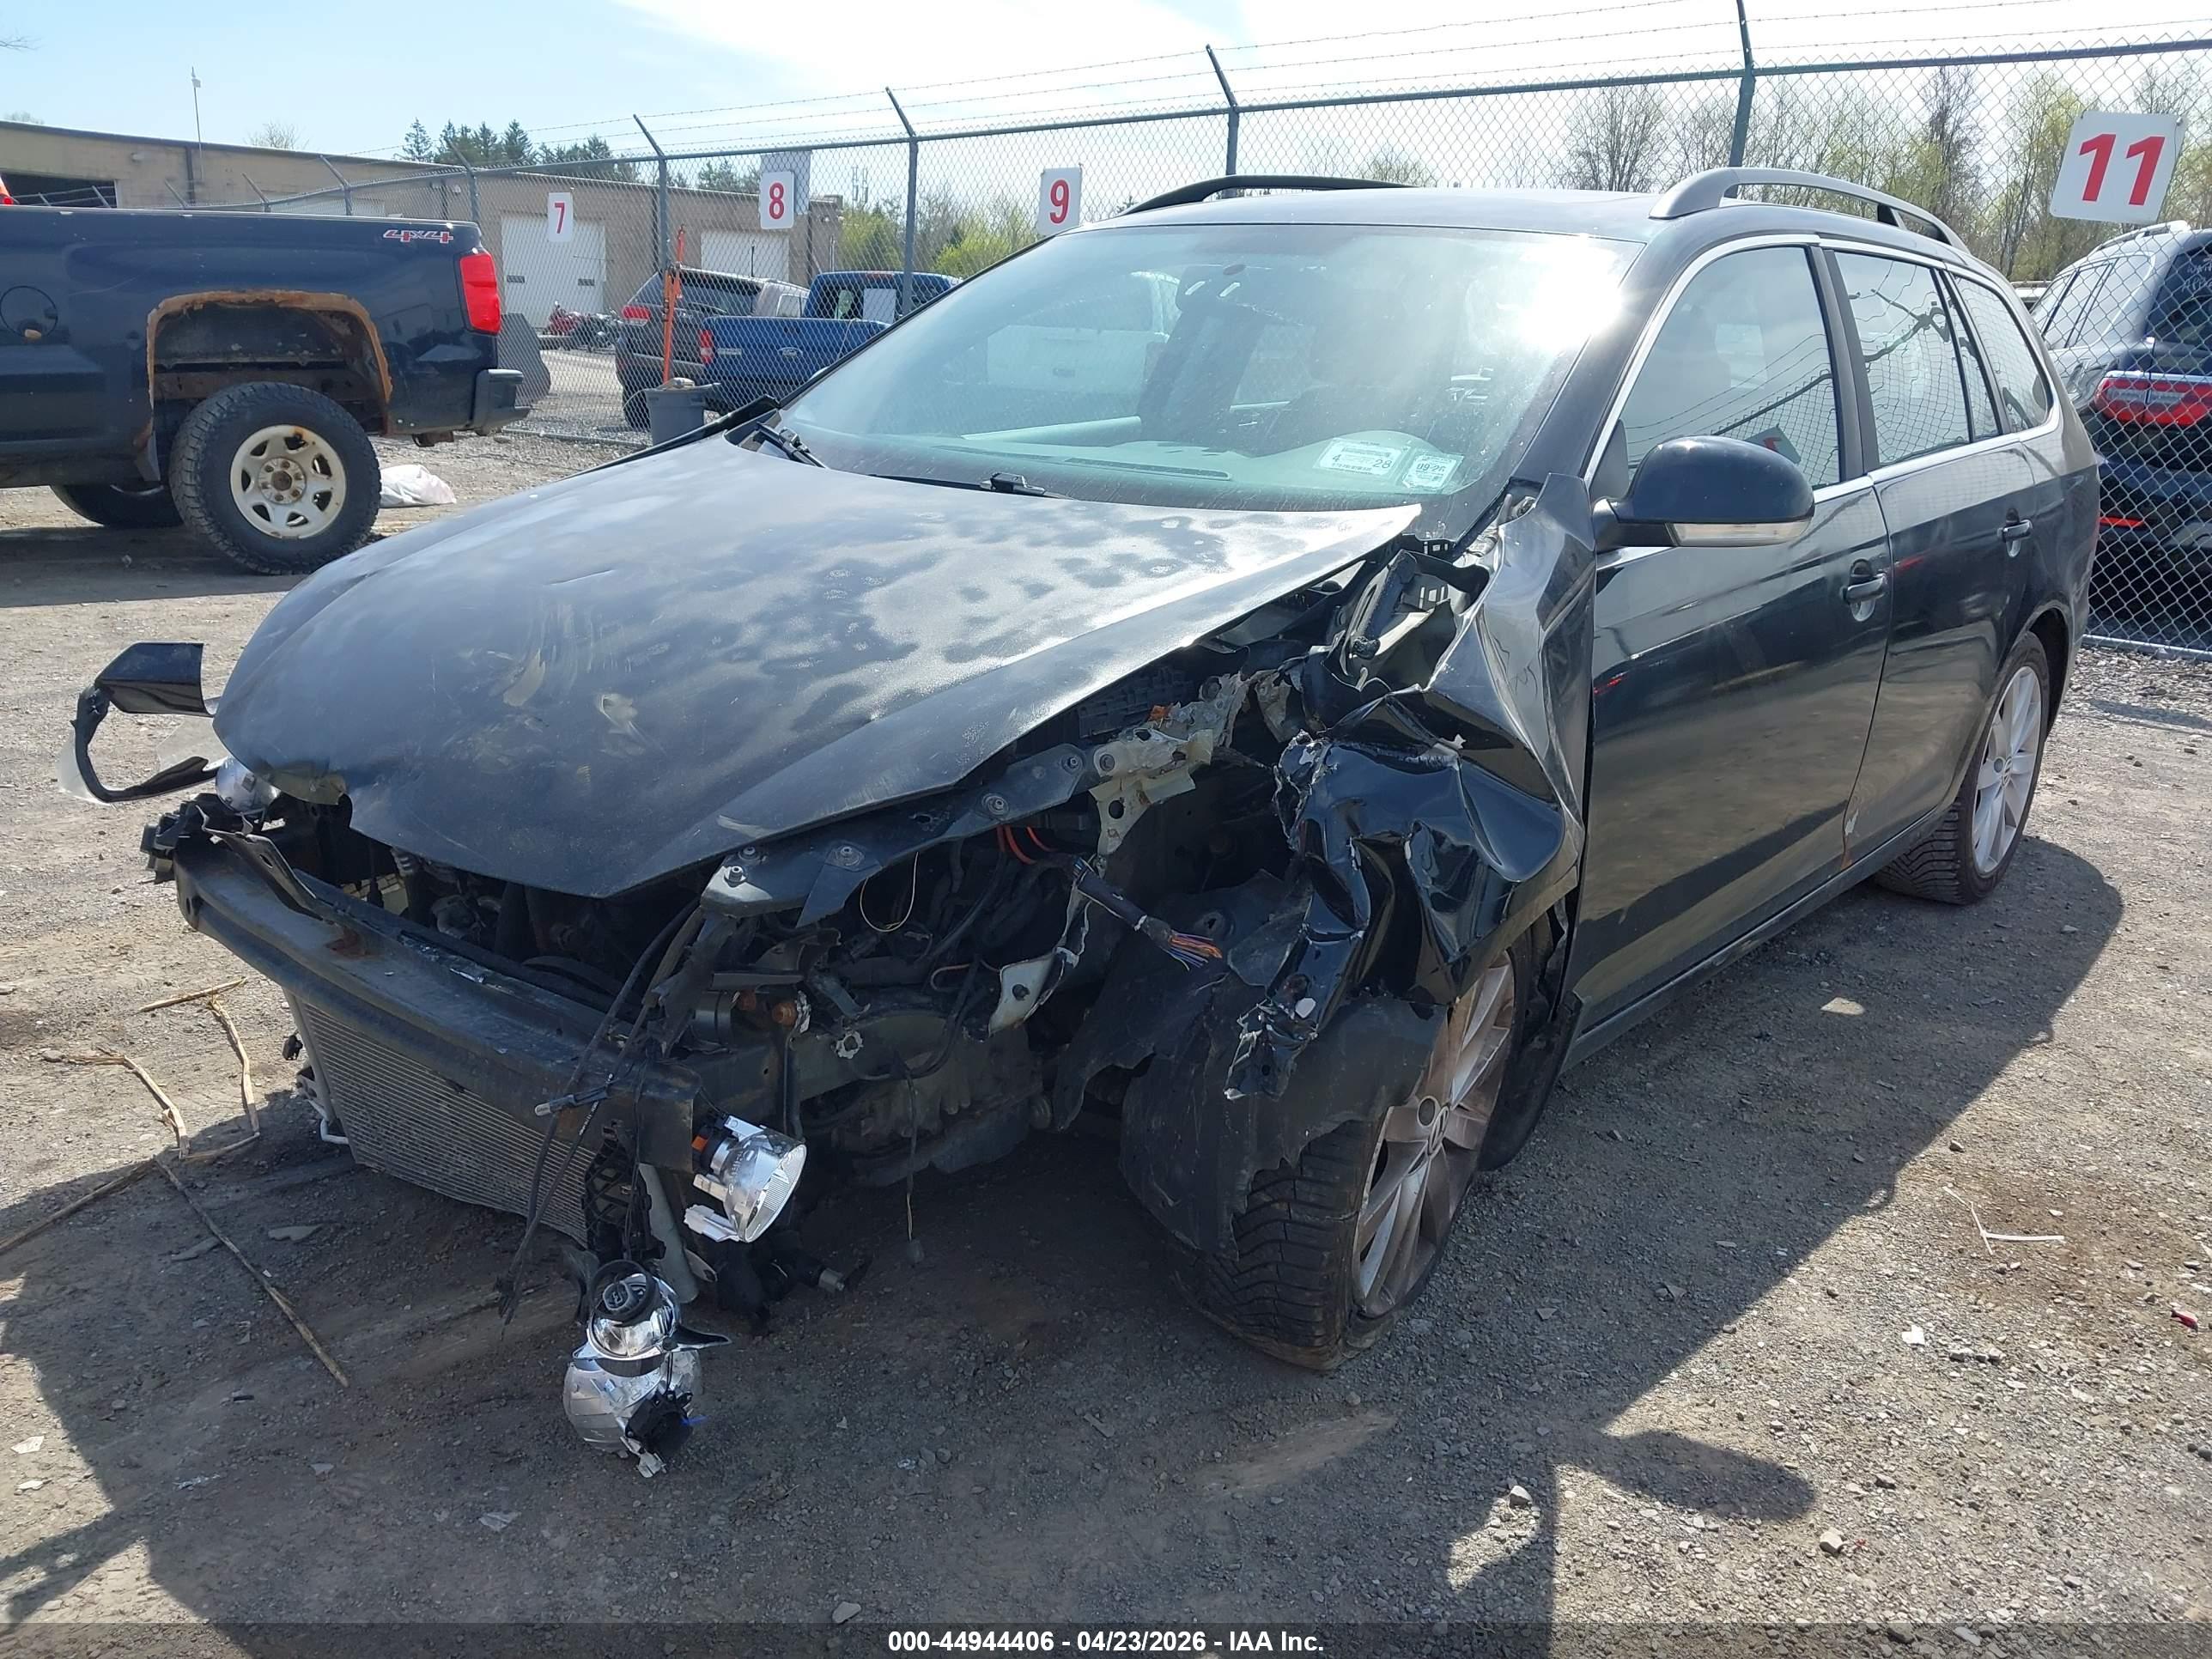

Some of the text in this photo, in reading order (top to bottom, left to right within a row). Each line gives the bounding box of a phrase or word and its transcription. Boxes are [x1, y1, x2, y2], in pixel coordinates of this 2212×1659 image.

[2080, 134, 2165, 206] 11
[554, 200, 565, 234] 7
[769, 182, 785, 220] 8
[1050, 180, 1069, 222] 9
